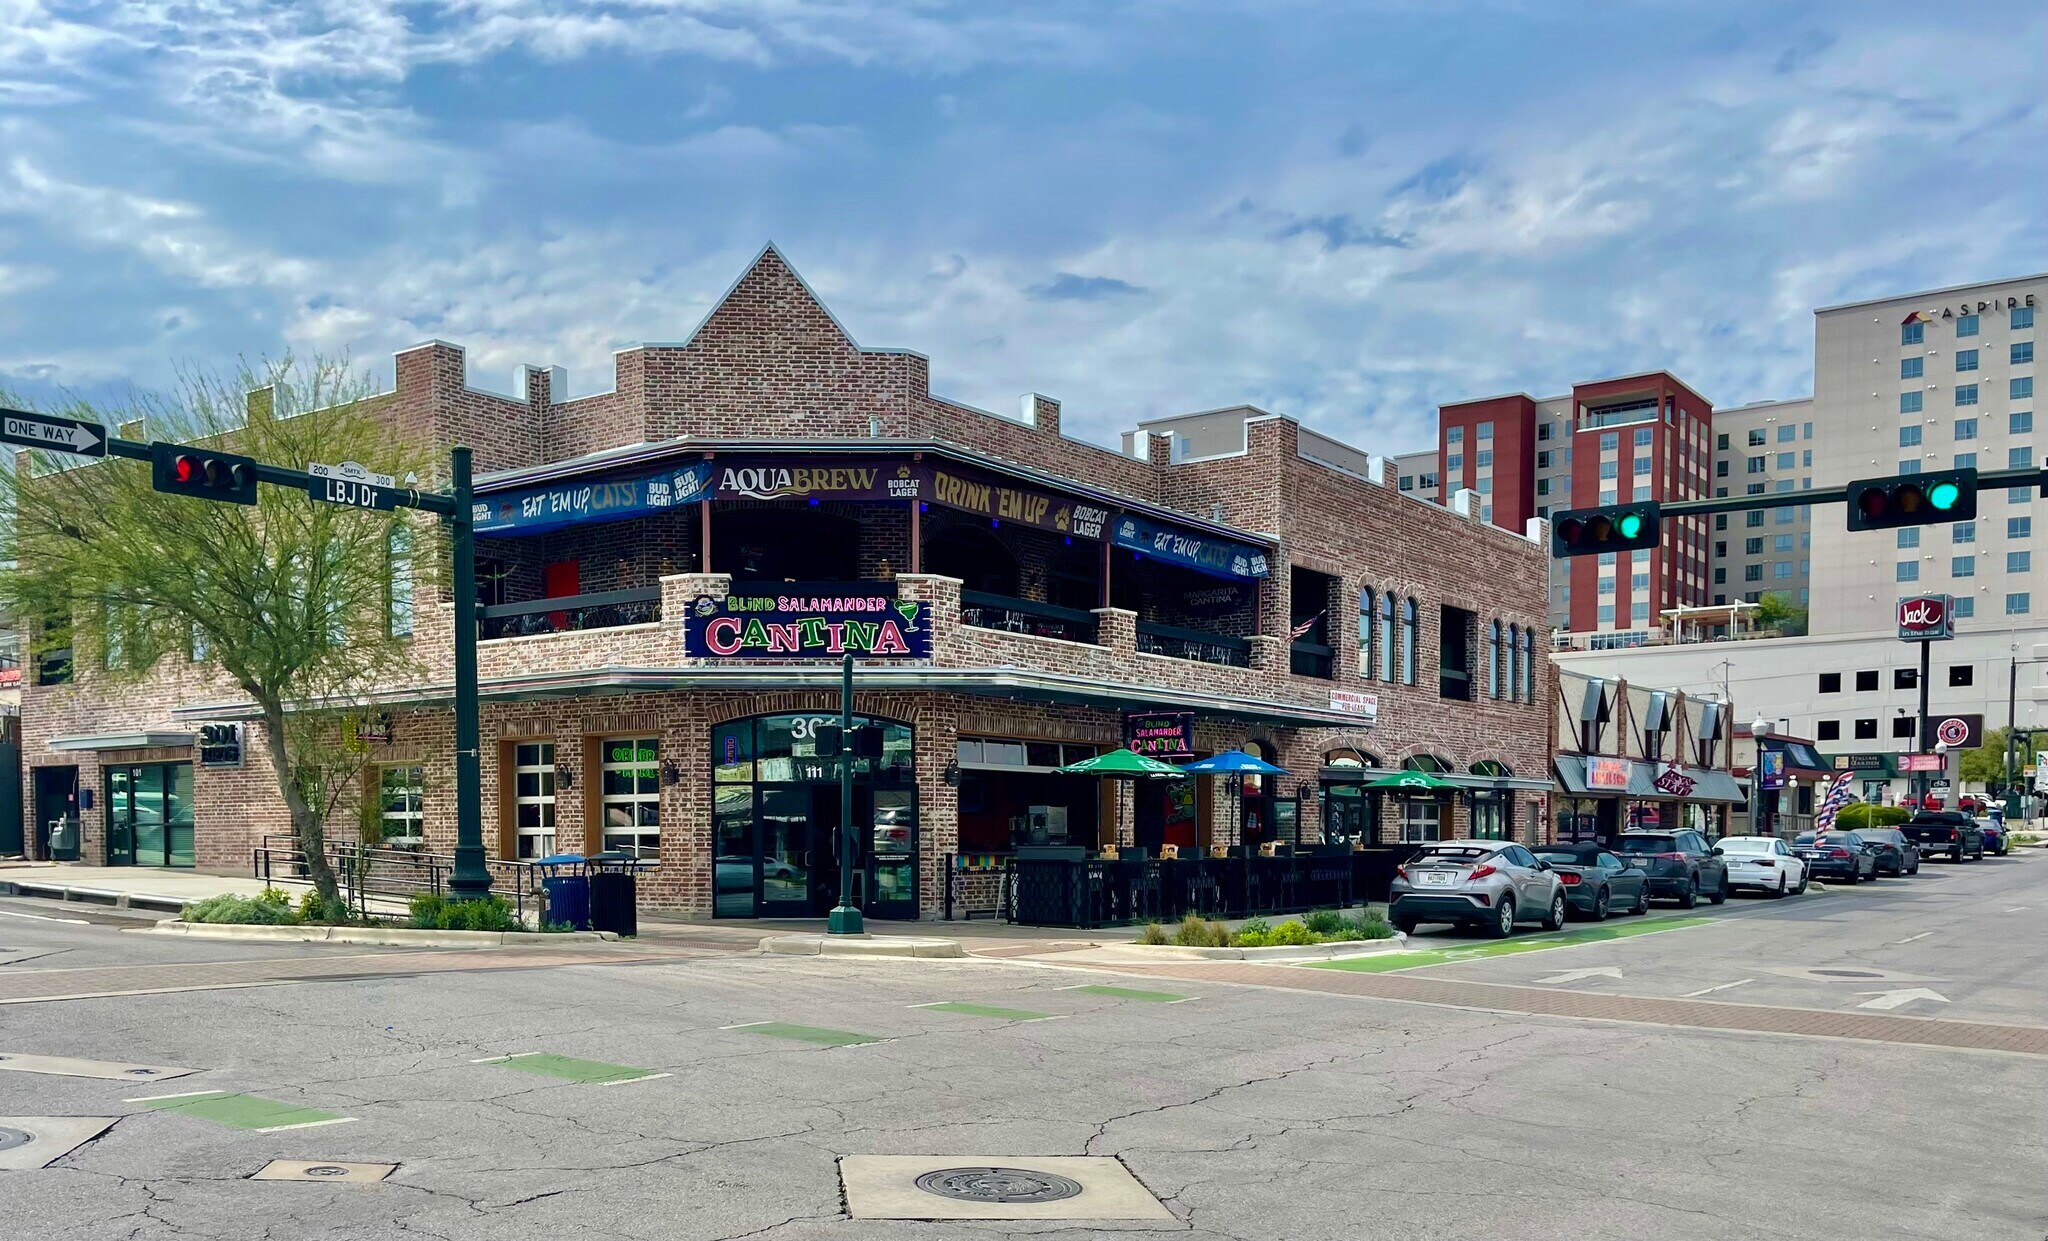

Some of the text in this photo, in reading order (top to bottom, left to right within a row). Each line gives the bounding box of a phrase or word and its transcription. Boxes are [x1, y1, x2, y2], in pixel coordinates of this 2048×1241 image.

[1942, 294, 2034, 319] ASPIRE
[8, 420, 75, 442] ONE WAY
[313, 465, 329, 476] 200
[375, 475, 391, 486] 300
[673, 470, 695, 488] BUD
[887, 479, 920, 489] BOBCAT
[326, 479, 378, 508] LBJ Dr
[648, 482, 670, 494] BUD
[674, 479, 700, 501] LIGHT
[890, 488, 918, 497] LAGER
[646, 494, 672, 506] LIGHT
[934, 471, 991, 513] DRINK
[1024, 494, 1050, 525] UP
[472, 503, 488, 513] BUD
[521, 494, 546, 518] EAT
[473, 511, 492, 521] IGHT
[1073, 505, 1108, 525] BOBCAT
[1073, 520, 1102, 539] LAGER
[1154, 532, 1174, 551] EAT
[1233, 554, 1248, 568] BUD
[1250, 553, 1266, 565] BUD
[1231, 563, 1249, 576] LIGHT
[778, 596, 887, 612] SALAMANDER
[1190, 595, 1232, 606] CANTINA
[1900, 601, 1942, 626] Jack
[705, 617, 910, 656] CANTINA
[1362, 696, 1377, 706] SPACE
[200, 724, 238, 746] 301
[1135, 726, 1183, 738] SALAMANDER
[1130, 738, 1189, 754] CANTINA
[132, 768, 142, 777] 101
[805, 766, 823, 778] 111
